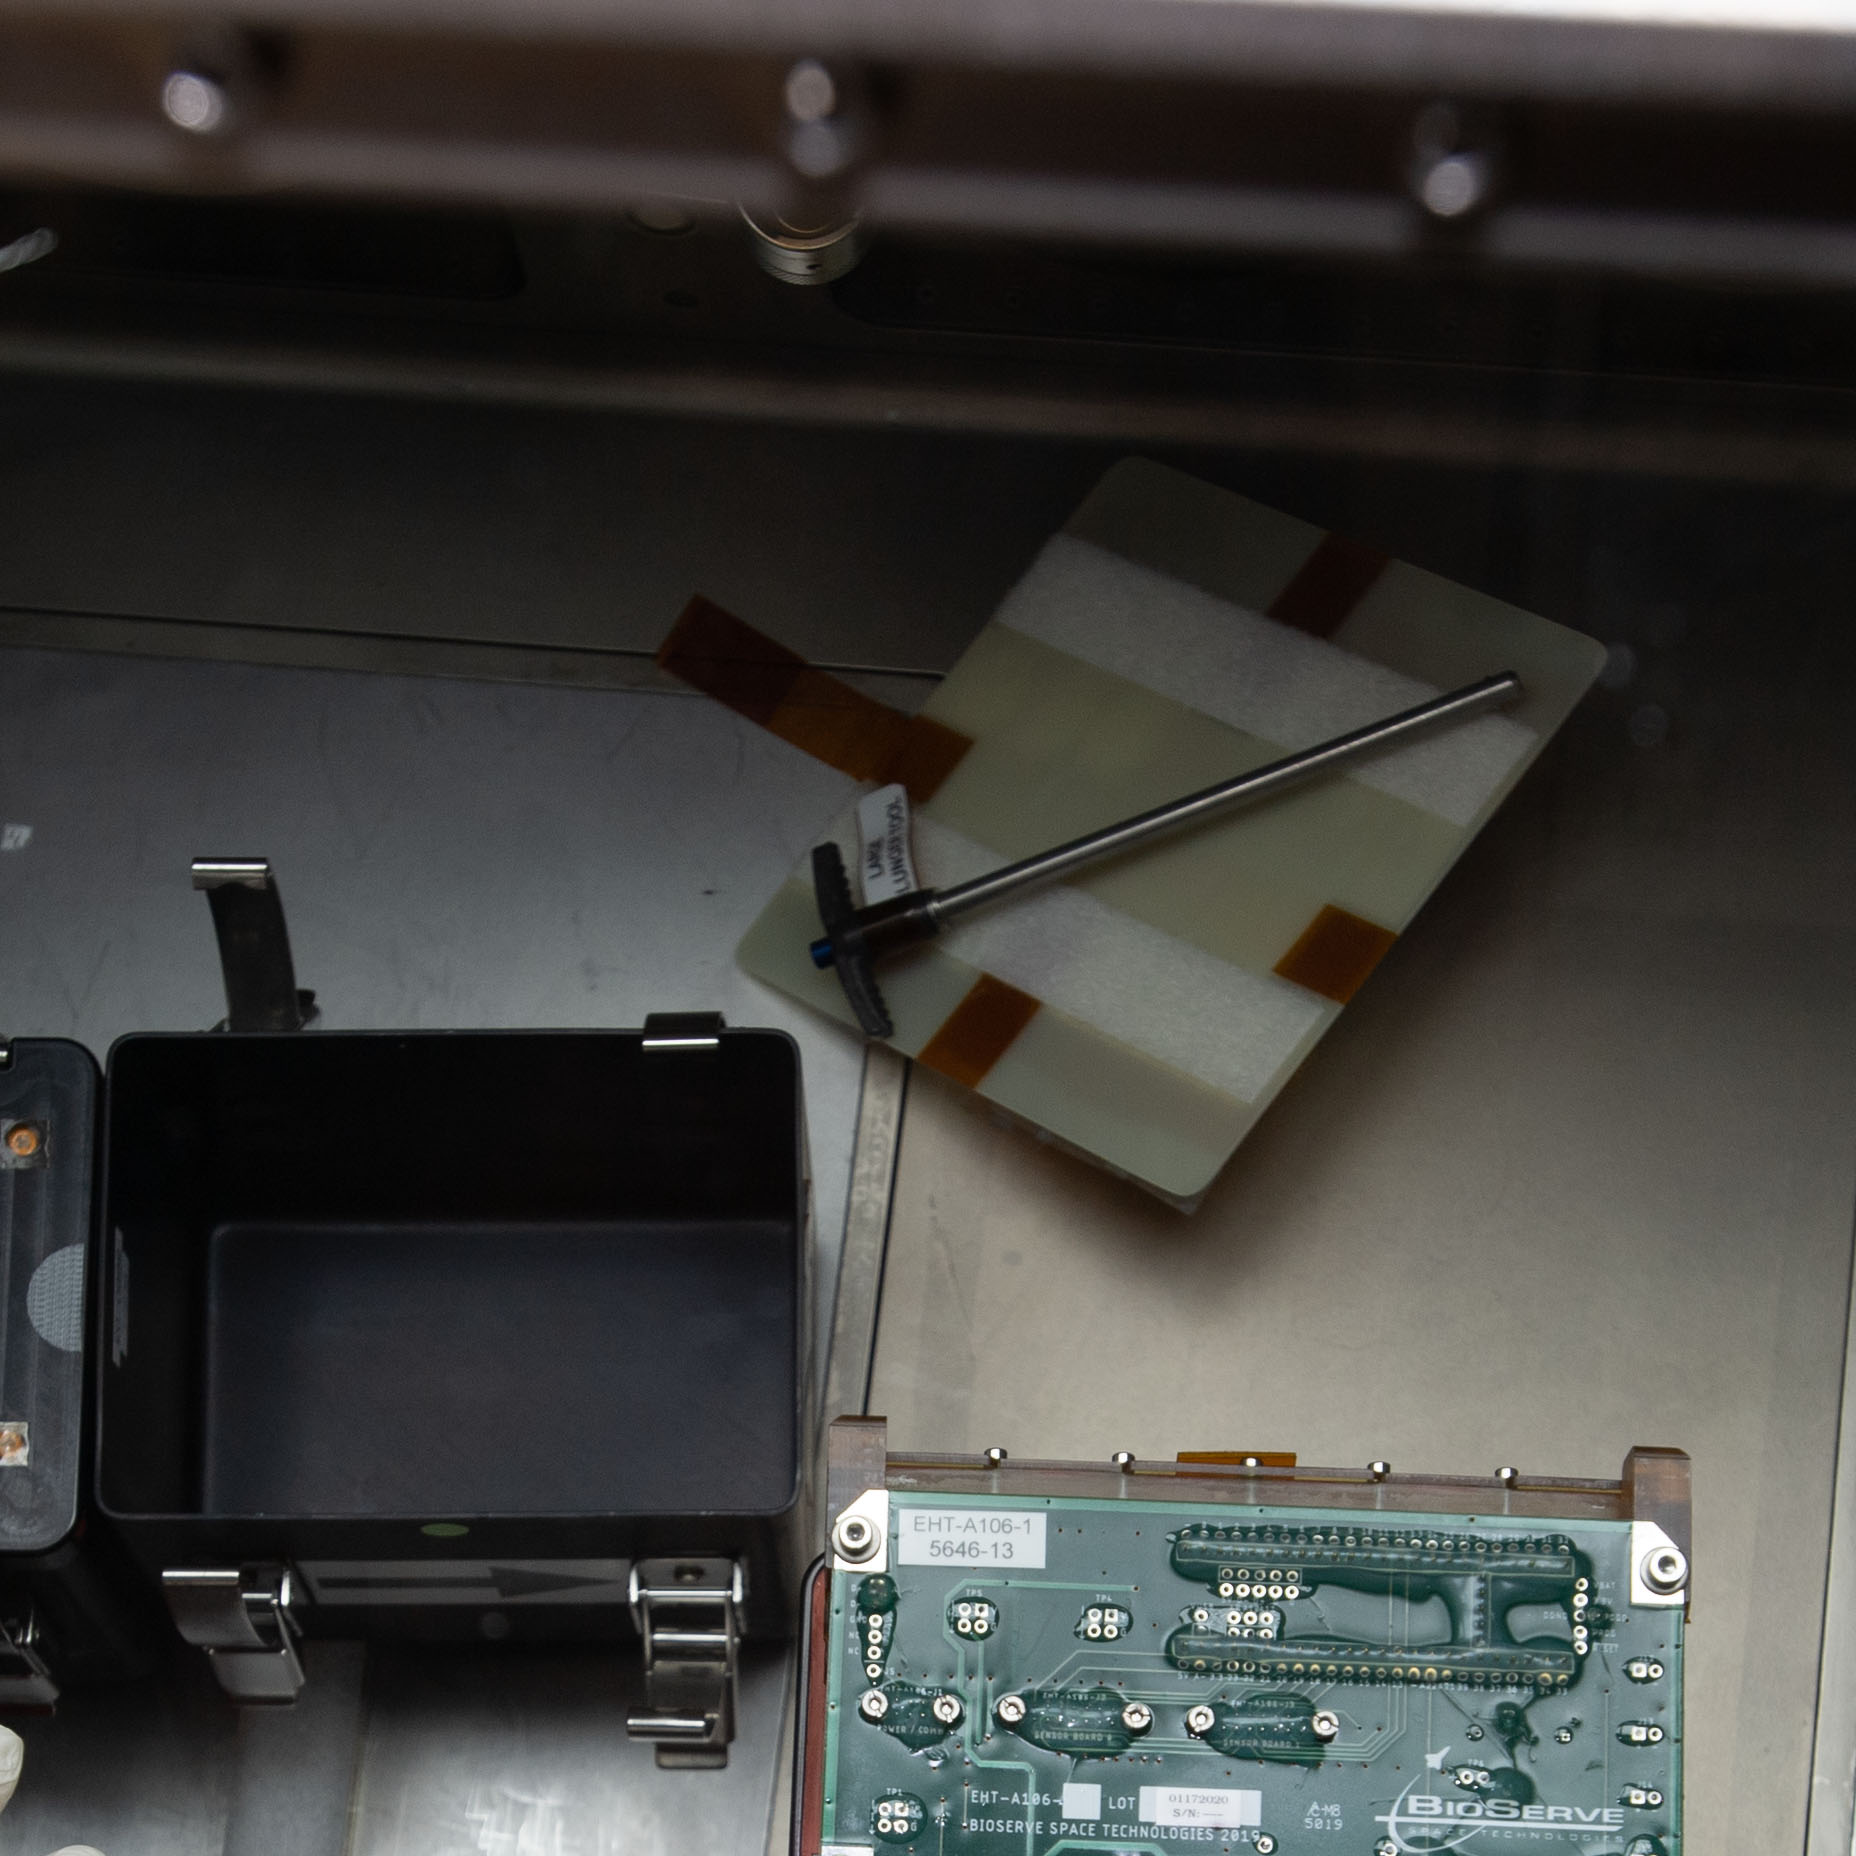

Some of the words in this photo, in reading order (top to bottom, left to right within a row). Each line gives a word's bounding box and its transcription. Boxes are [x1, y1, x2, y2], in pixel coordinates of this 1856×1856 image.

[913, 1516, 1032, 1535] EHT-A106-1
[929, 1540, 1014, 1559] 5646-13
[971, 1790, 1064, 1806] EHT-A106-
[1108, 1797, 1136, 1810] LOT
[1169, 1794, 1229, 1805] 01172020
[970, 1819, 1044, 1835] BIOSERVE
[1049, 1822, 1096, 1837] SPACE
[1103, 1823, 1215, 1841] TECHNOLOGIES
[1221, 1829, 1260, 1843] 2019
[1304, 1818, 1343, 1830] 5019
